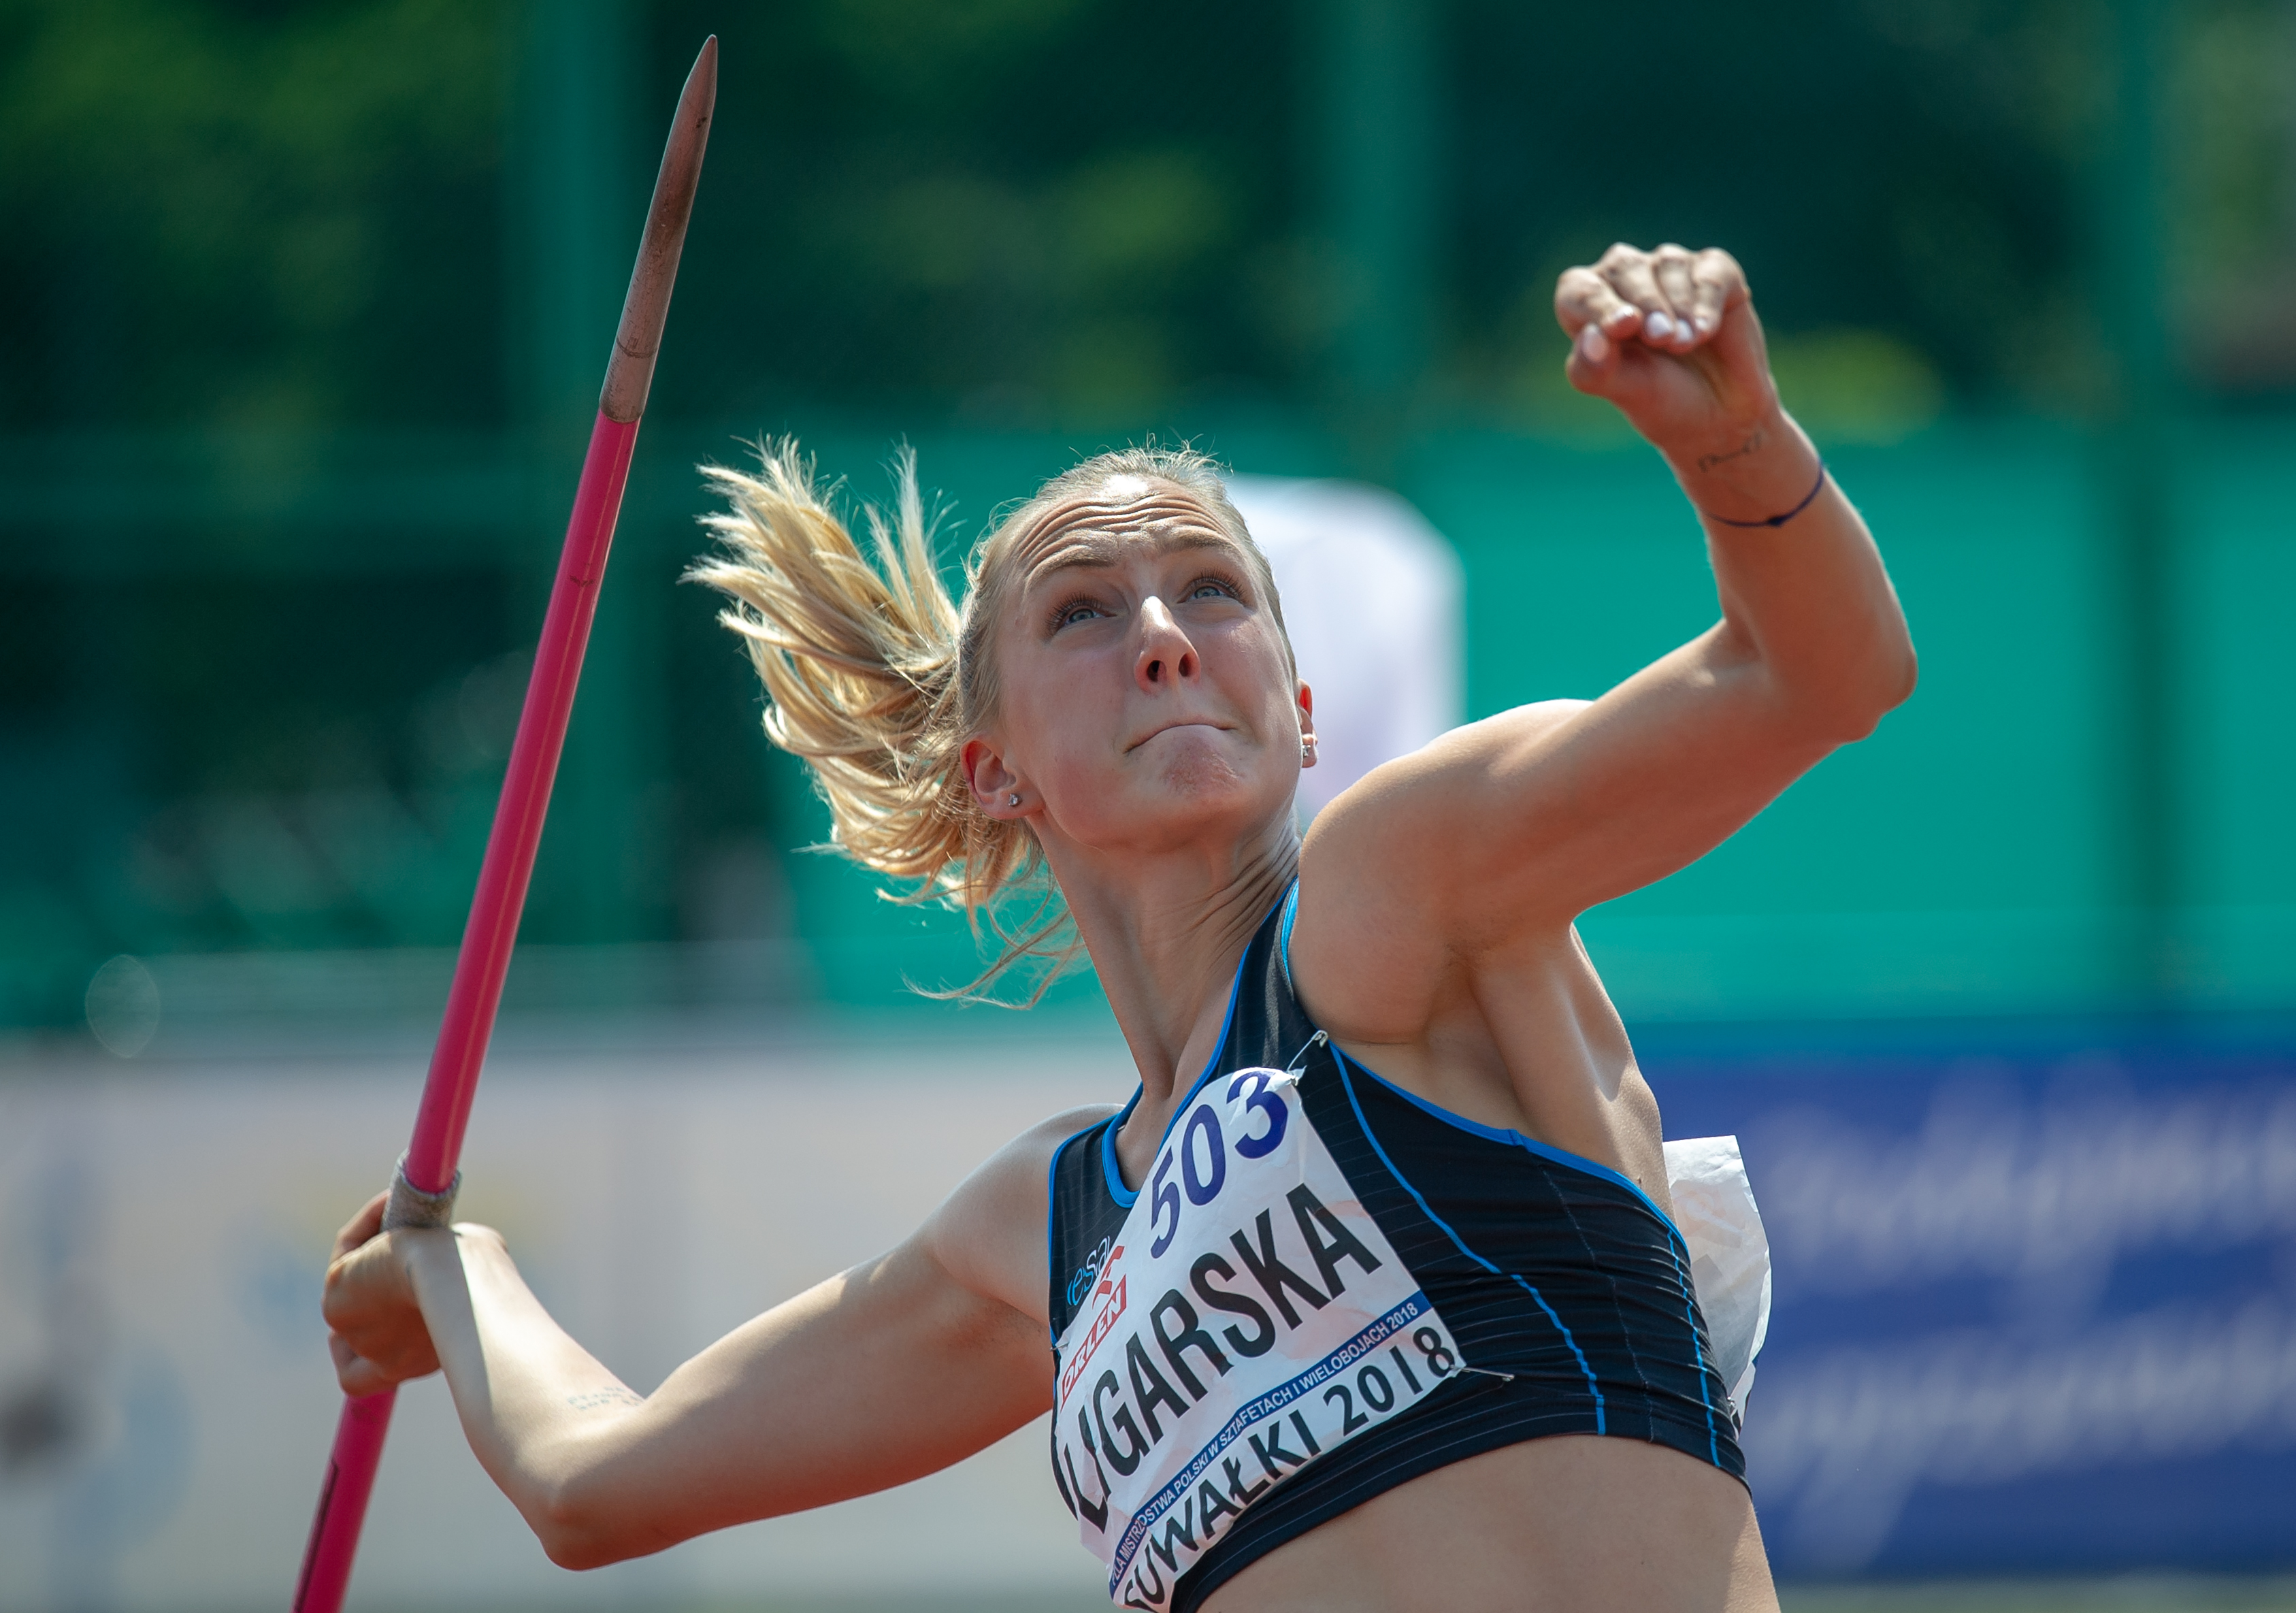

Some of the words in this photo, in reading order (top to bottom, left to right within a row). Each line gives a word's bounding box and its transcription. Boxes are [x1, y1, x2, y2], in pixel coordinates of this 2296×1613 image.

[1151, 1071, 1288, 1259] 503
[1063, 1281, 1124, 1395] ORLEN
[1174, 1454, 1209, 1495] POLSKI
[1209, 1441, 1219, 1458] W
[1219, 1386, 1294, 1447] SZTAFETACH
[1293, 1384, 1300, 1395] I
[1298, 1321, 1390, 1390] WIELOBOJACH
[1386, 1302, 1418, 1331] 2018
[1323, 1326, 1455, 1437] 2018
